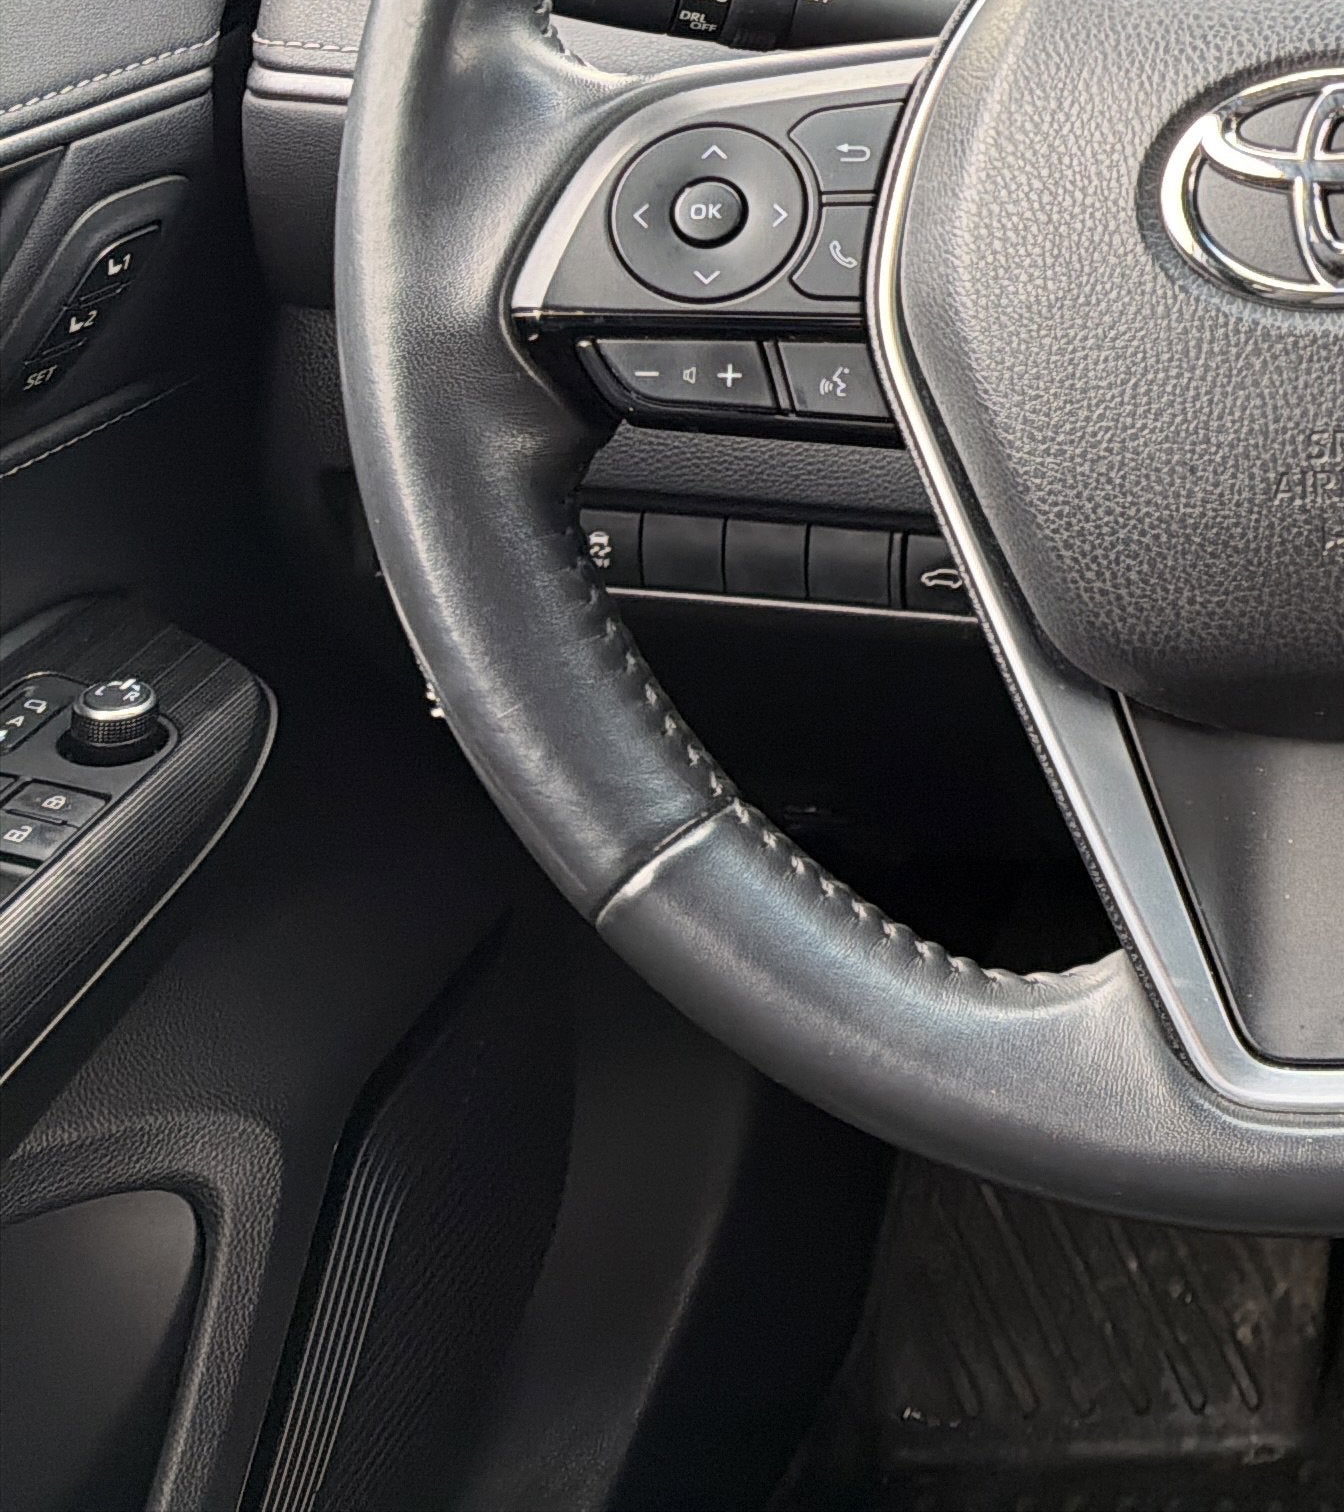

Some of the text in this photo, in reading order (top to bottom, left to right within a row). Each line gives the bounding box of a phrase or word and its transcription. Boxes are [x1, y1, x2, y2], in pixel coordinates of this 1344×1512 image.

[679, 10, 707, 24] DRL
[689, 21, 718, 32] OFF
[690, 203, 723, 220] OK
[23, 365, 58, 391] SET
